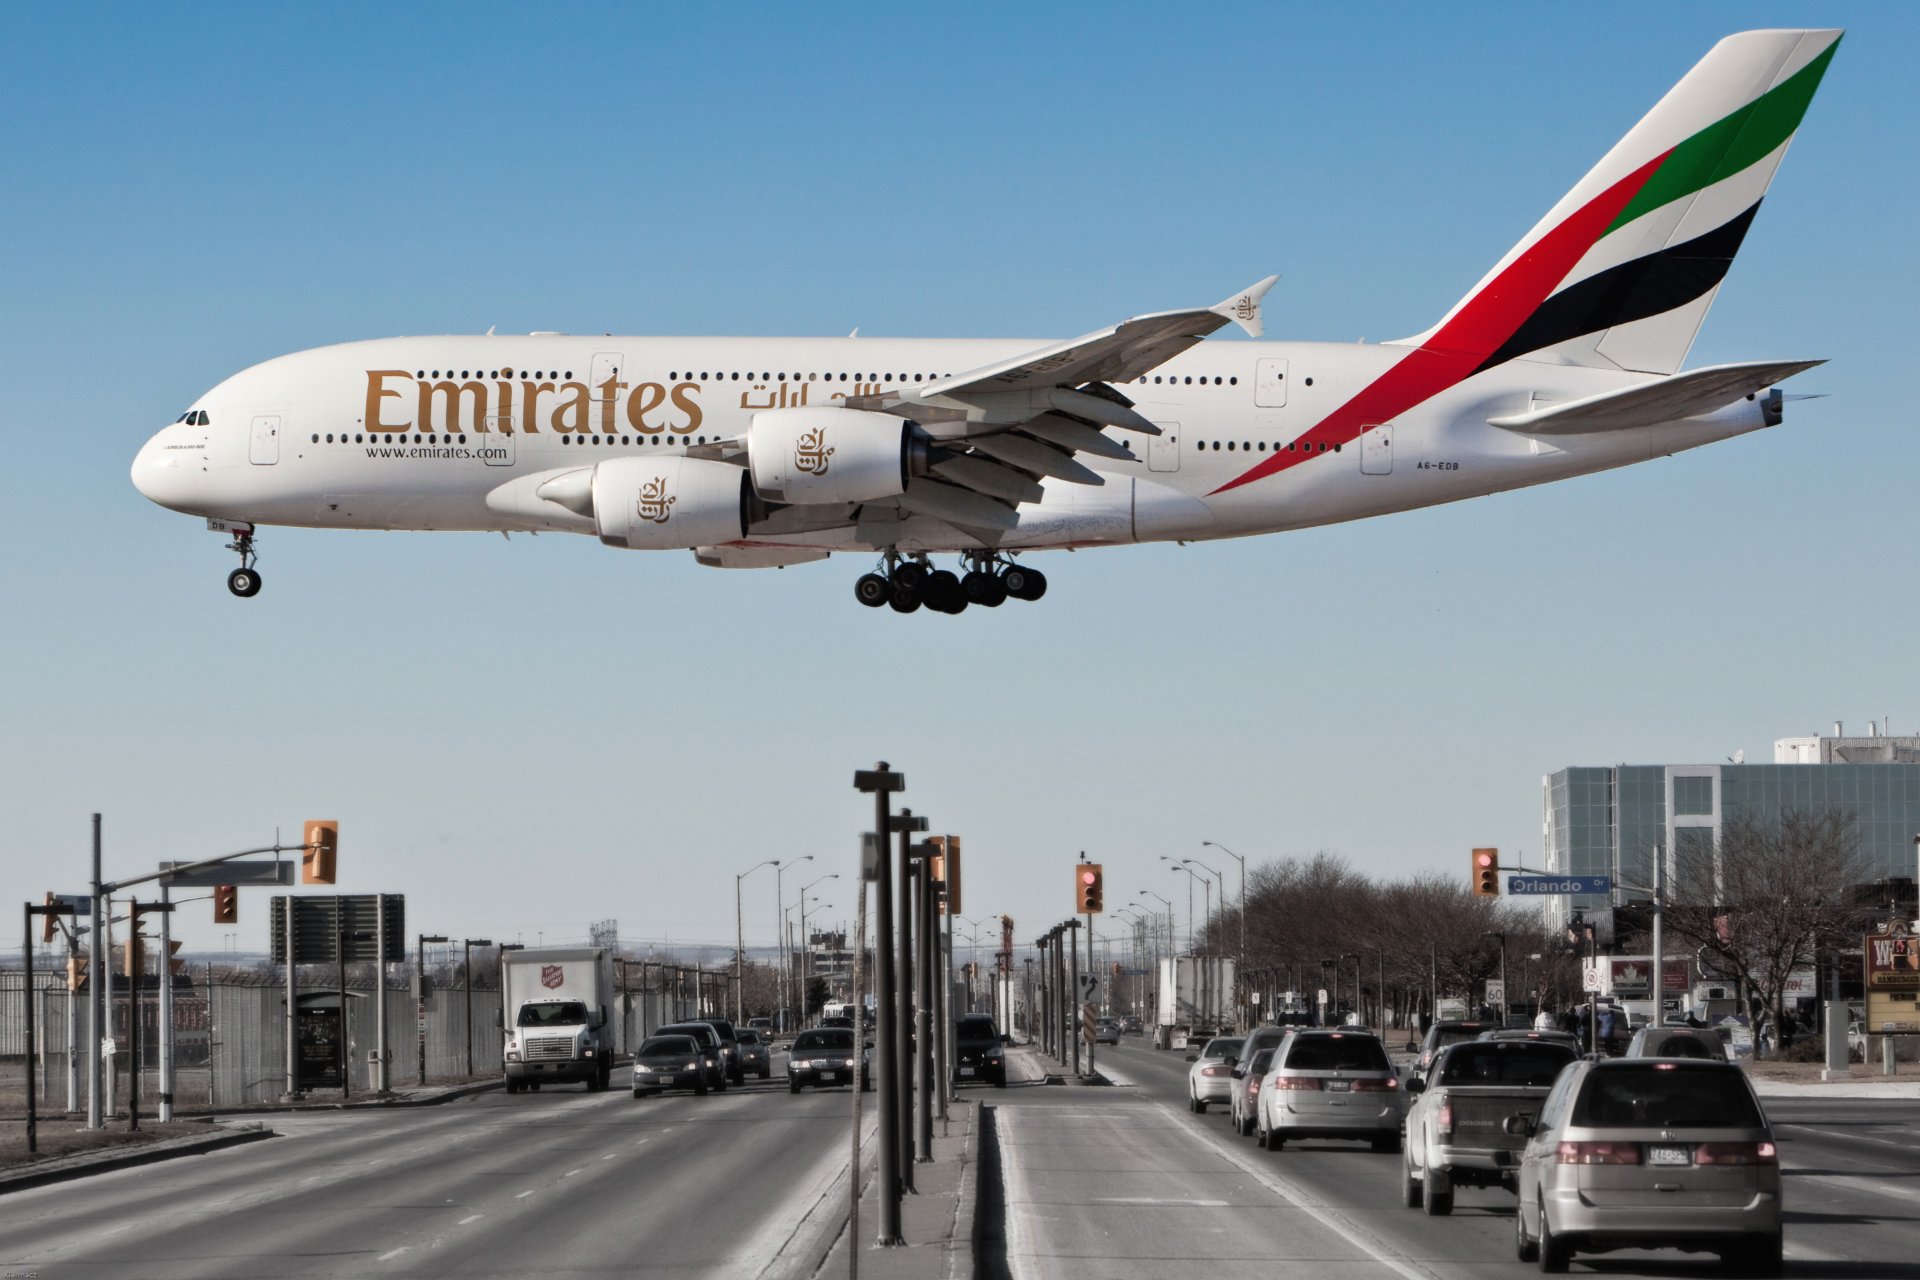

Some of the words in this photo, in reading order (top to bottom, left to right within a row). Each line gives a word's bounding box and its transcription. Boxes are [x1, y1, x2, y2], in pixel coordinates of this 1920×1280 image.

[364, 367, 703, 435] Emirates
[365, 445, 507, 460] www.emirates.com
[1417, 462, 1459, 471] A6-EDB
[1513, 879, 1582, 892] Orlando
[1488, 989, 1503, 1000] 60
